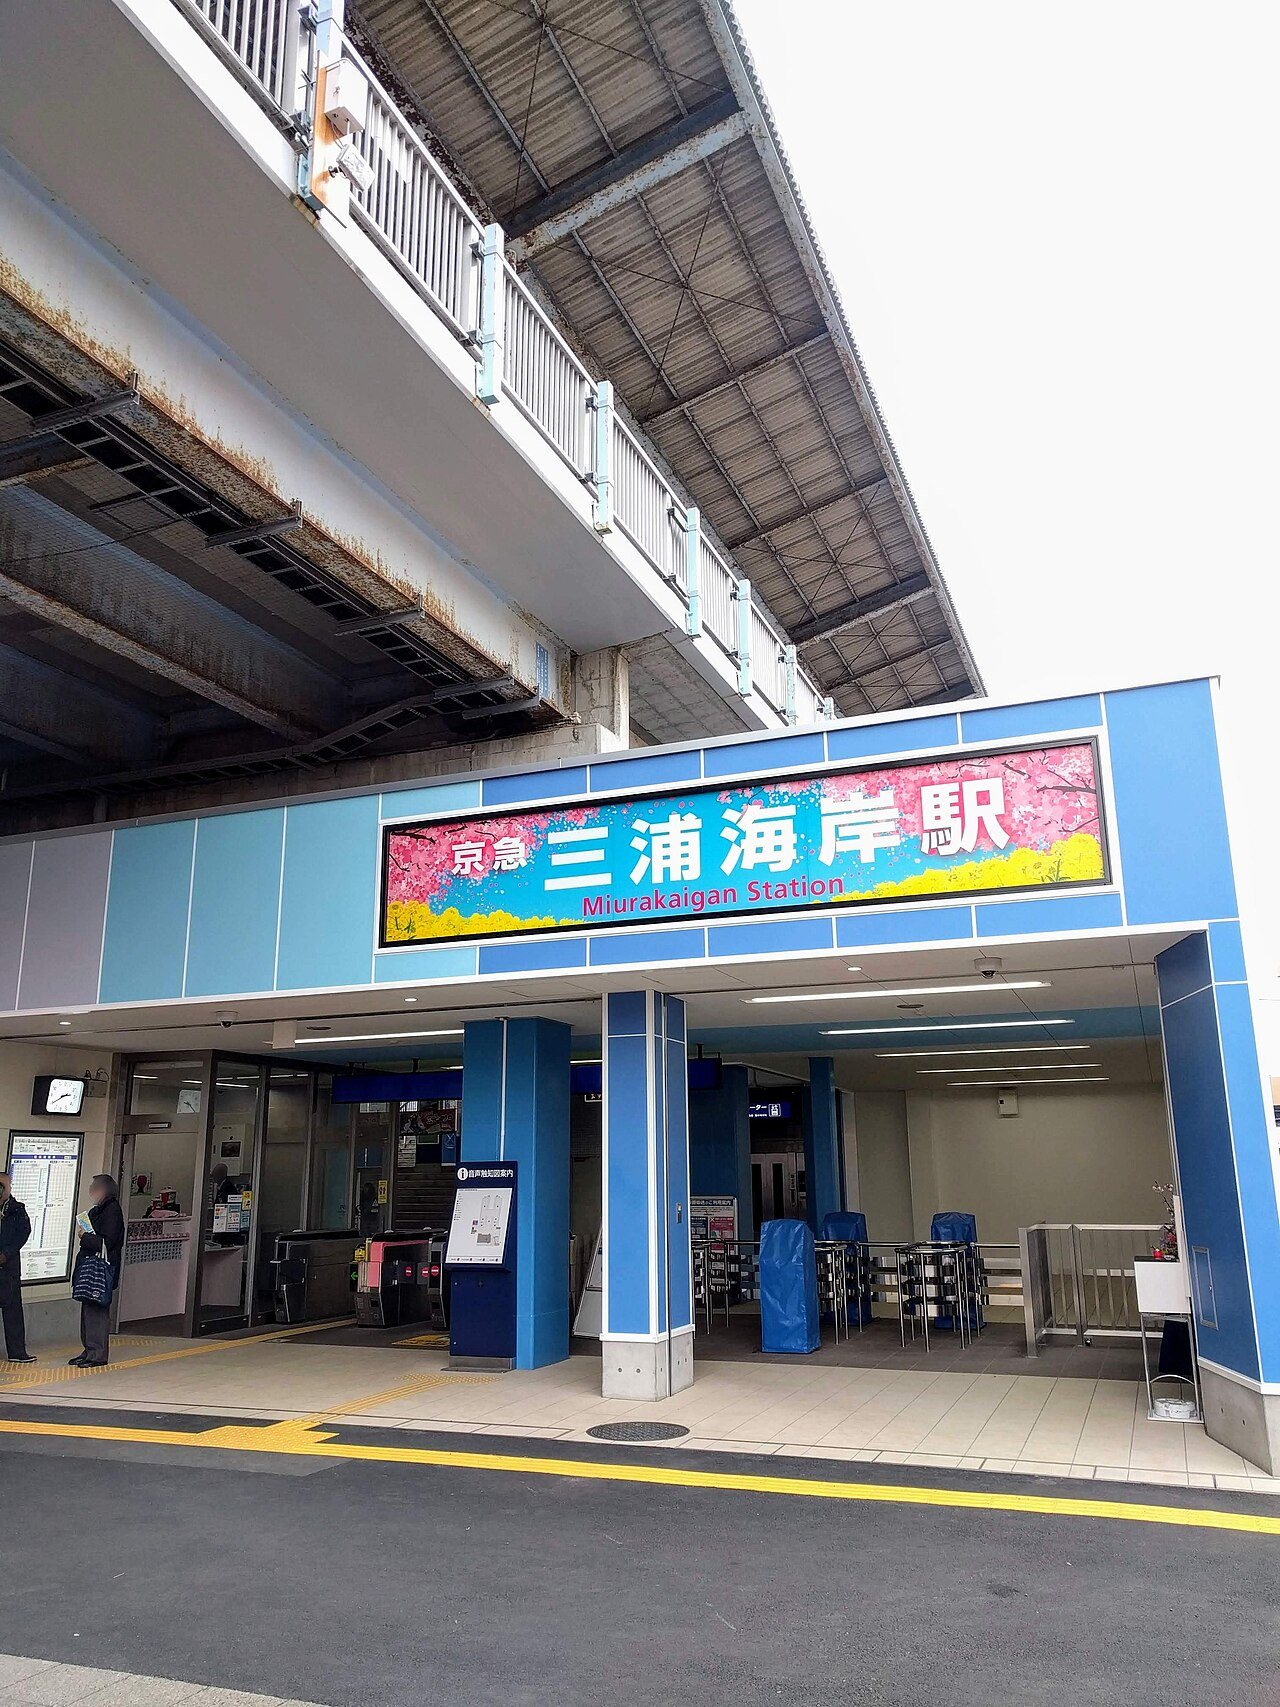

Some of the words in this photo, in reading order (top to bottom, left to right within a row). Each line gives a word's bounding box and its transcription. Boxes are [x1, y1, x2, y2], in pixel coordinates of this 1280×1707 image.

[452, 836, 528, 875] 京急
[544, 777, 1011, 891] 三浦海岸駅
[583, 887, 737, 916] Miurakaigan
[747, 876, 844, 901] Station
